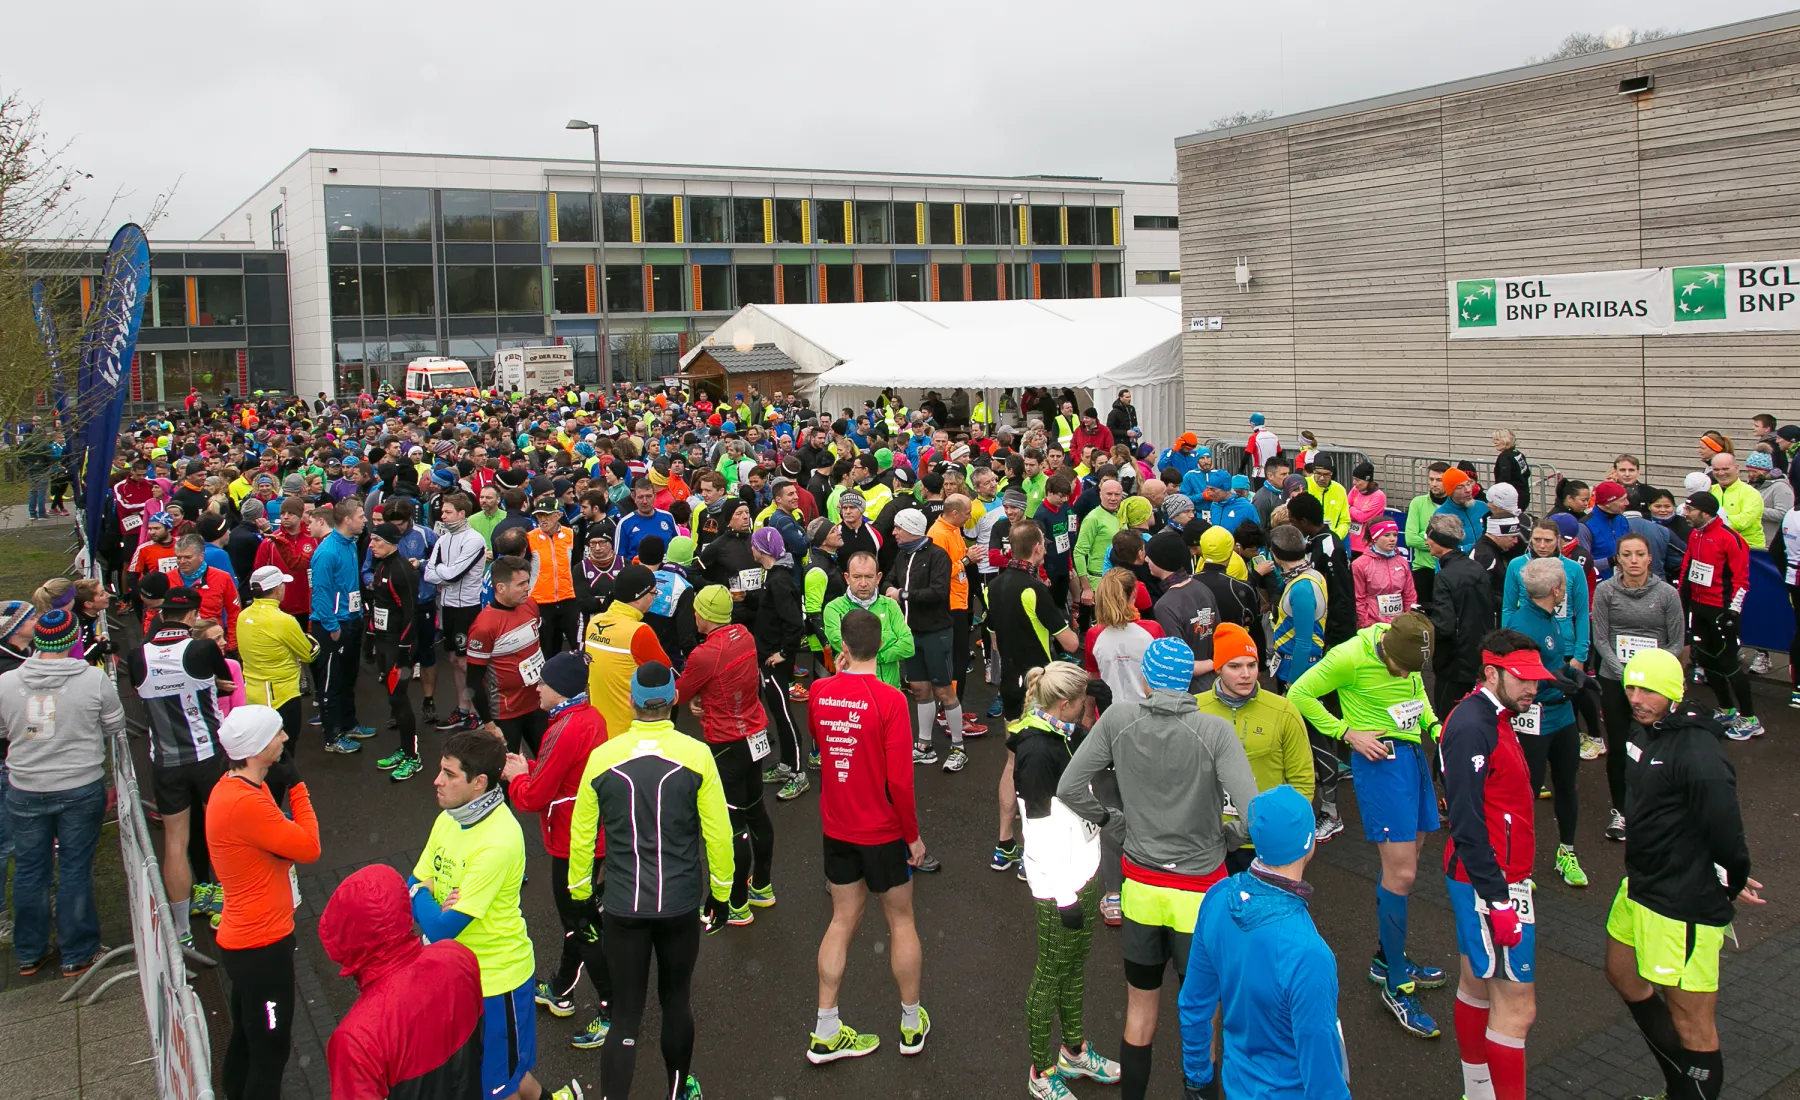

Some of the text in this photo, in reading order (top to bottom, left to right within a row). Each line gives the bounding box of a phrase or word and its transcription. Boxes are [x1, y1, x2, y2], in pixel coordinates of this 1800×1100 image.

[1738, 265, 1800, 288] BGL
[1505, 280, 1551, 299] BGL
[1739, 292, 1796, 313] BNP
[1506, 299, 1648, 321] BNP PARIBAS
[1192, 319, 1204, 327] WC
[746, 578, 759, 587] 774
[155, 682, 186, 691] BoConcept
[819, 696, 869, 710] rockandroad.ie
[820, 719, 862, 729] amphibian
[831, 726, 850, 734] king
[755, 739, 768, 754] 975
